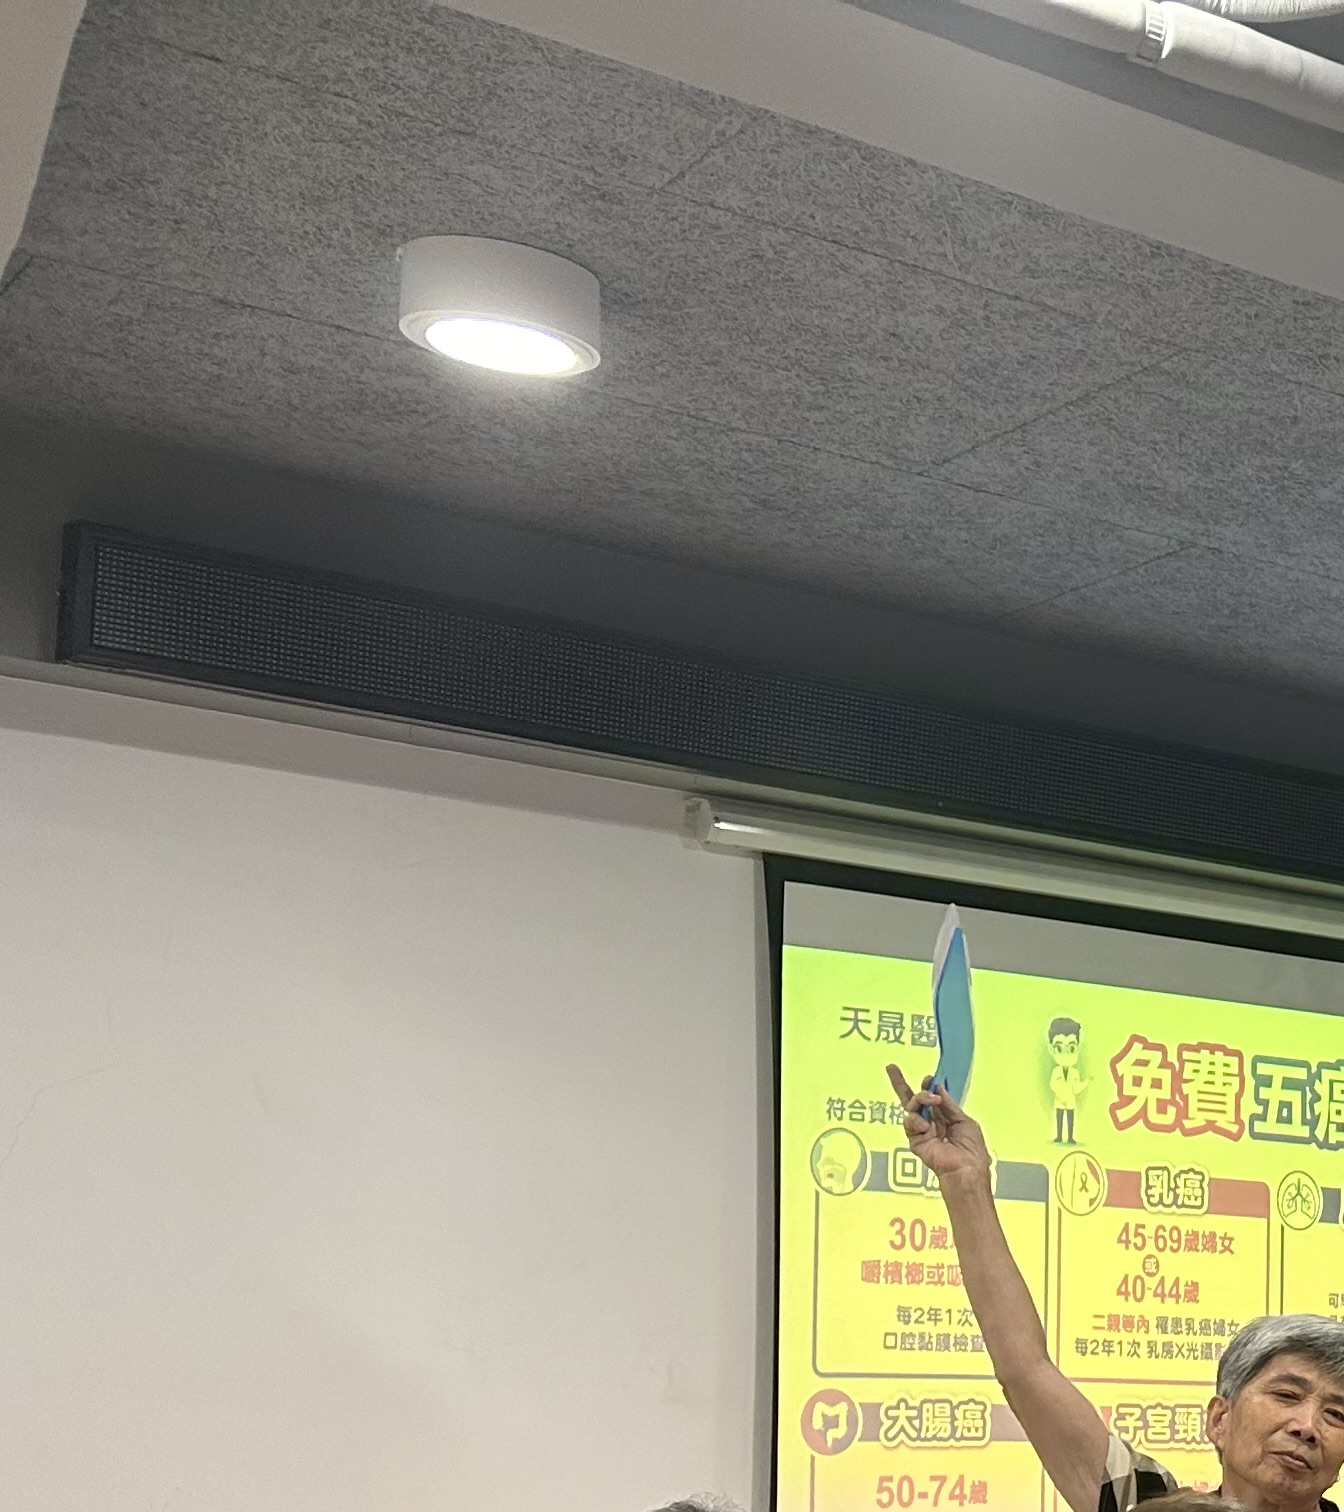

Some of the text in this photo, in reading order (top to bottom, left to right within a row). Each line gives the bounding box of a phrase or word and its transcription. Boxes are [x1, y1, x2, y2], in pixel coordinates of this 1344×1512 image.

[1144, 1165, 1207, 1212] 乳癌
[896, 1305, 974, 1327] 每2年1次
[1074, 1337, 1141, 1359] 每2年1次
[884, 1398, 987, 1442] 大腸癌
[1114, 1406, 1214, 1446] 子宮頸
[875, 1474, 988, 1509] 50-74歲
